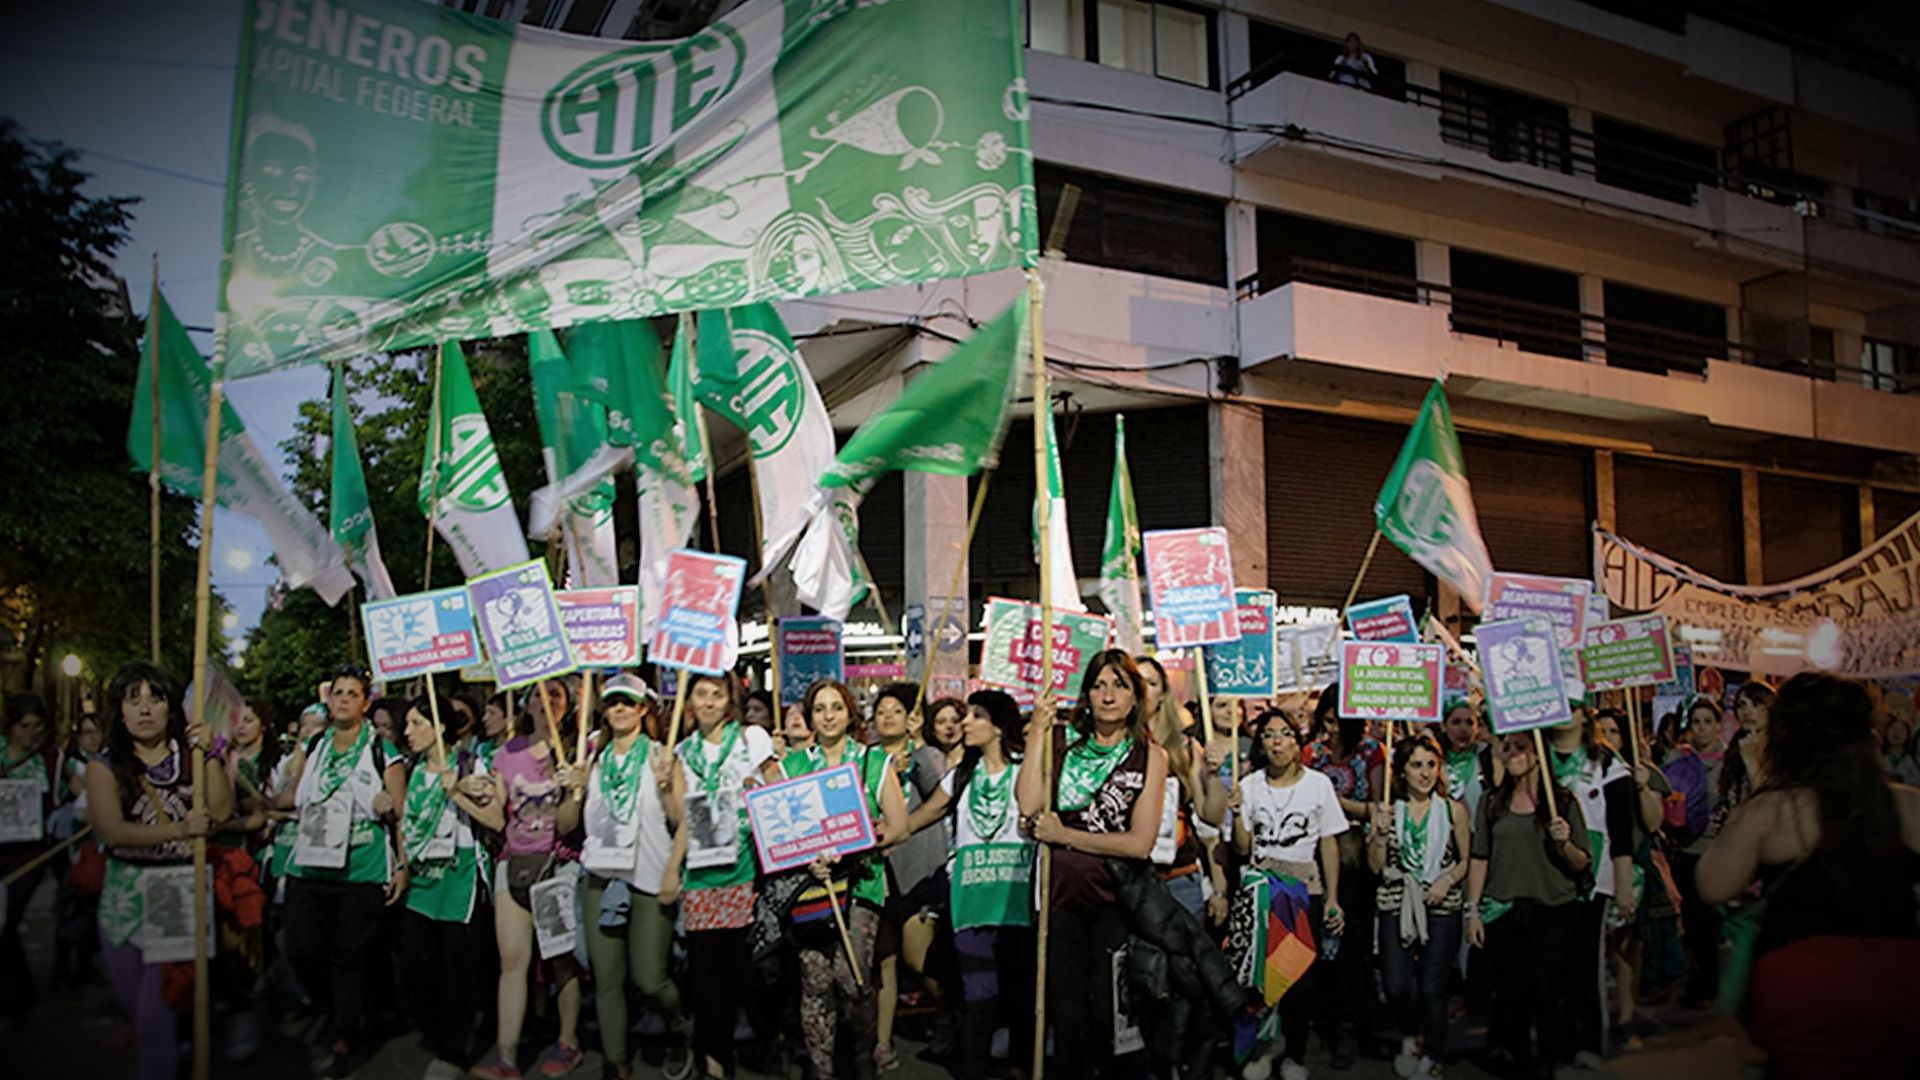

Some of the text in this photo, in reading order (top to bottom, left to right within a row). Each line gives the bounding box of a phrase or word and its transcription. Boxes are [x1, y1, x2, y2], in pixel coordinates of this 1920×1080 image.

[252, 47, 477, 129] APITAL FEDERAL
[560, 607, 621, 623] EAPERTURA
[1031, 624, 1067, 648] CPO
[1016, 643, 1074, 667] LABRAL
[1022, 664, 1065, 685] TRAS
[831, 827, 860, 841] MENOS
